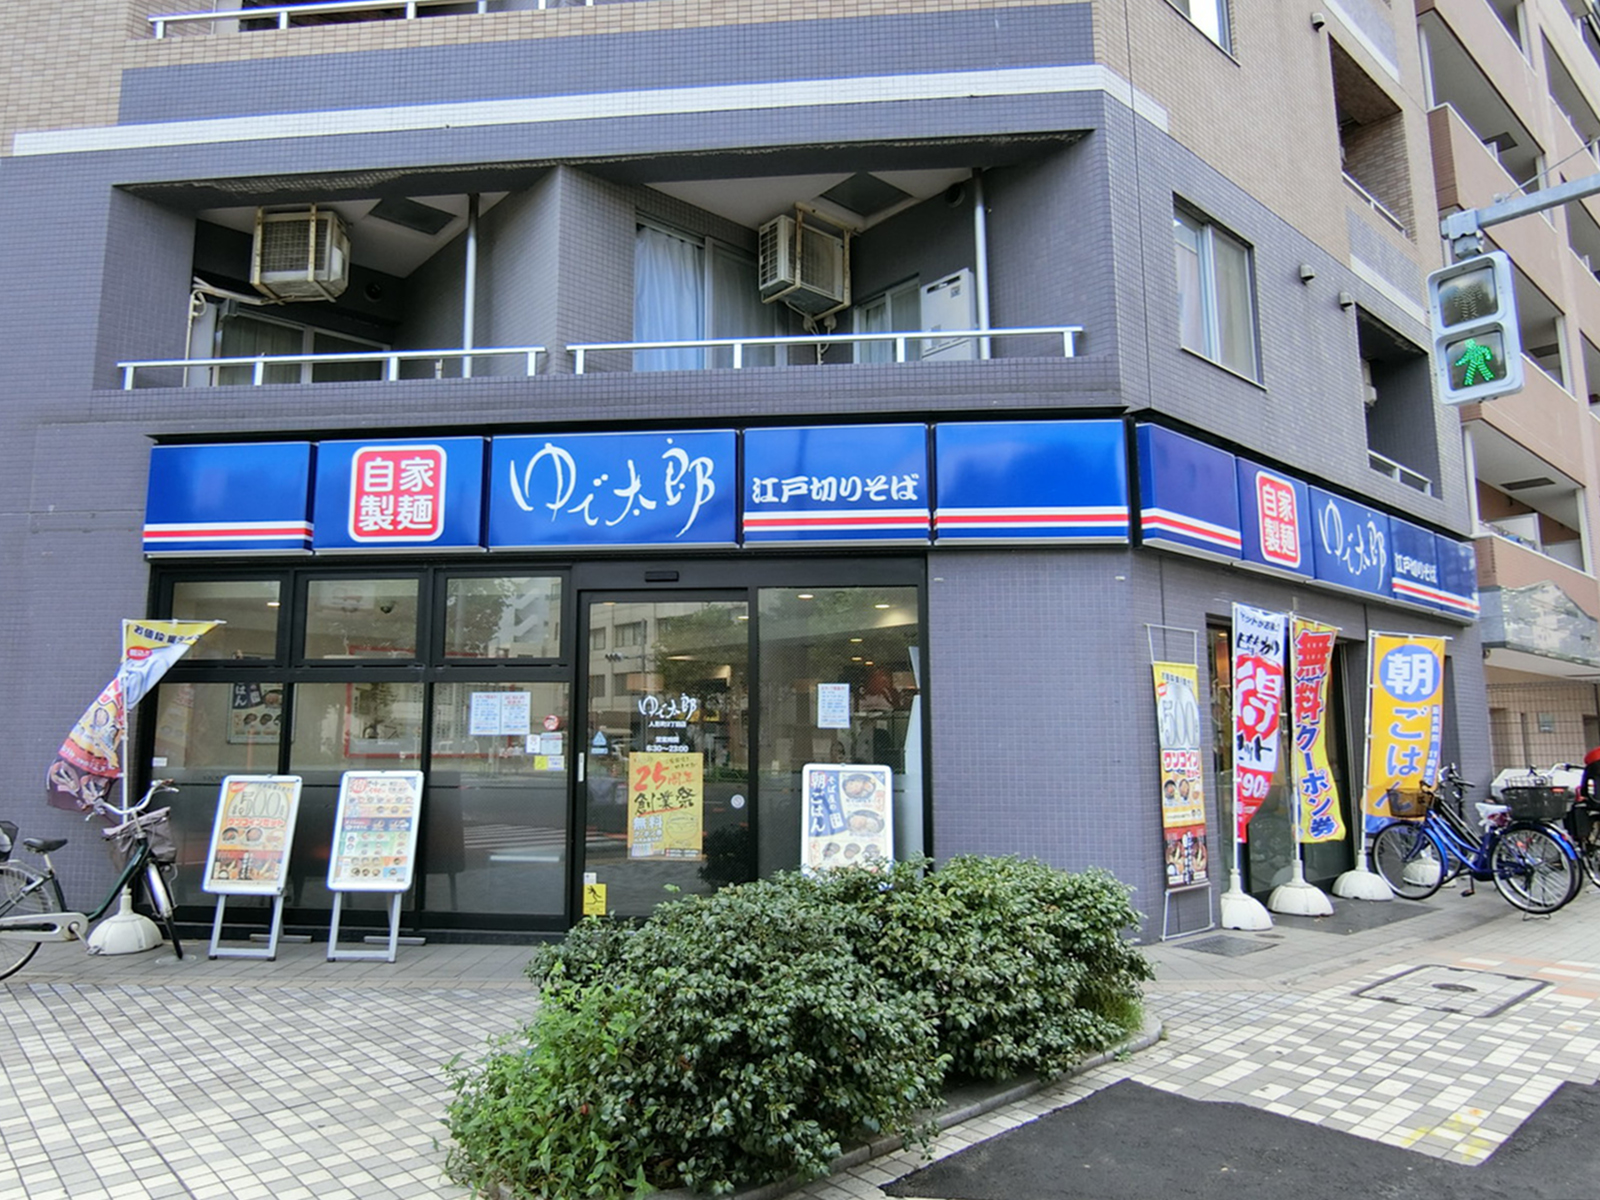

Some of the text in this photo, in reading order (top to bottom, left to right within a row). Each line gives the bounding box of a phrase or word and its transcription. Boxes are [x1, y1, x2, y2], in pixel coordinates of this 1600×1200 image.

[363, 455, 435, 493] 自家
[509, 437, 716, 538] ゆで太郎
[752, 473, 919, 504] 江戸切りそば
[359, 495, 433, 532] 製麺
[1261, 484, 1293, 521] 自家
[1264, 523, 1297, 558] 製麺
[1295, 631, 1338, 838] 無料クーポン券
[1375, 652, 1433, 812] 朝ごはん
[810, 772, 826, 833] 朝ごはん
